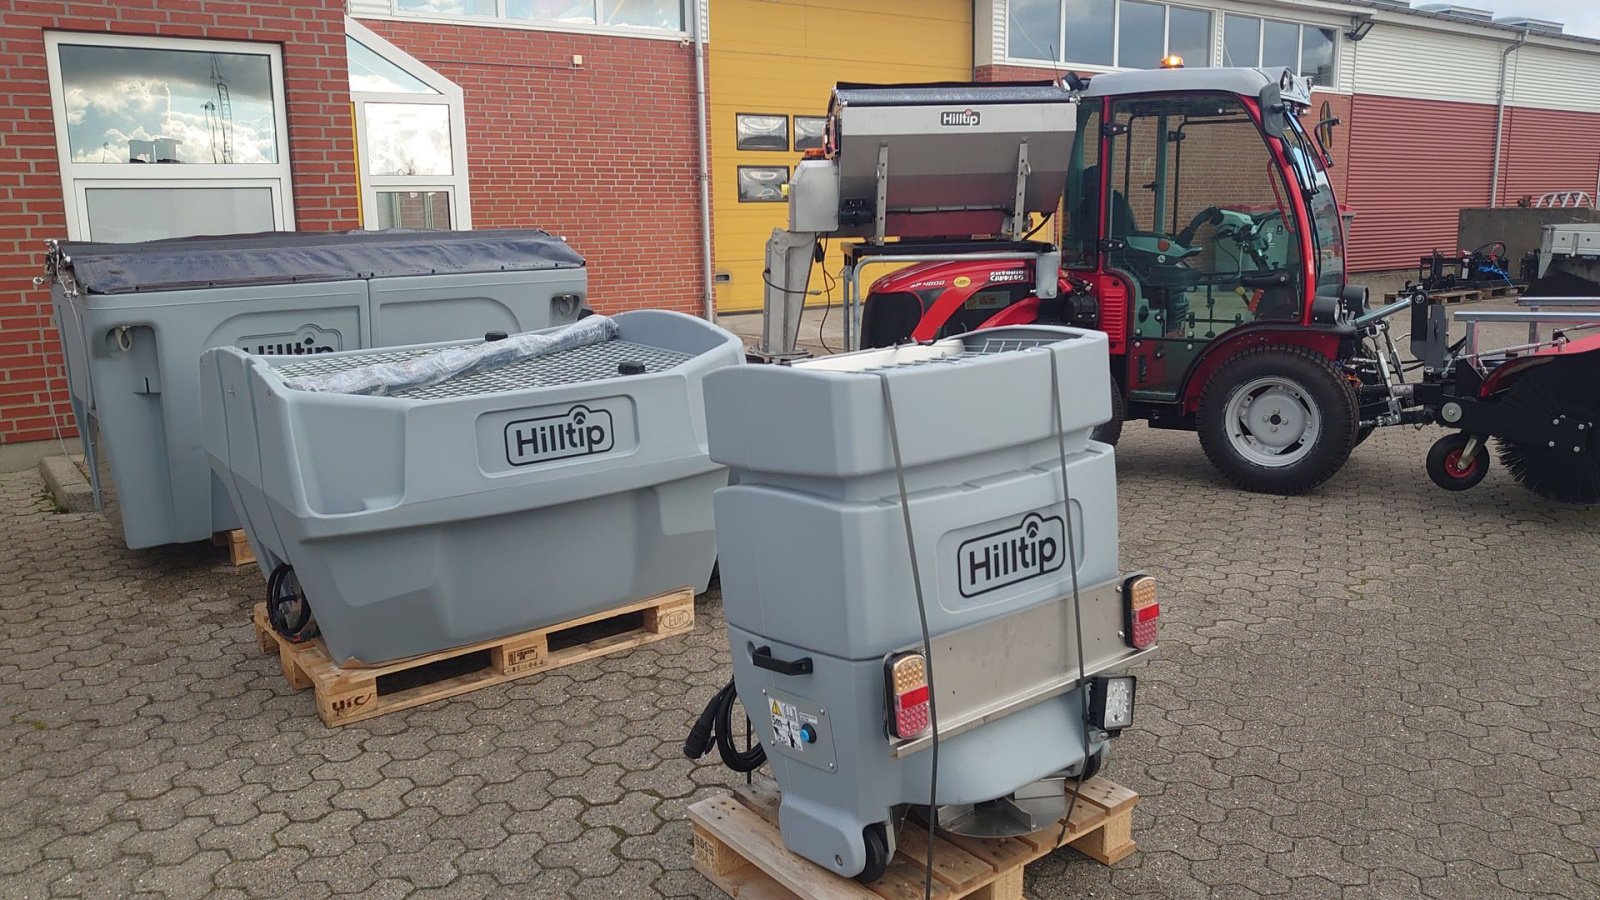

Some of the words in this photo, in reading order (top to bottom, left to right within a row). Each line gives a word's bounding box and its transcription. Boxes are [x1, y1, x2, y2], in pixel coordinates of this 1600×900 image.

[943, 111, 978, 126] Hilltip
[516, 412, 605, 456] Hilltip
[970, 521, 1057, 585] Hilltip
[668, 612, 684, 626] EUR
